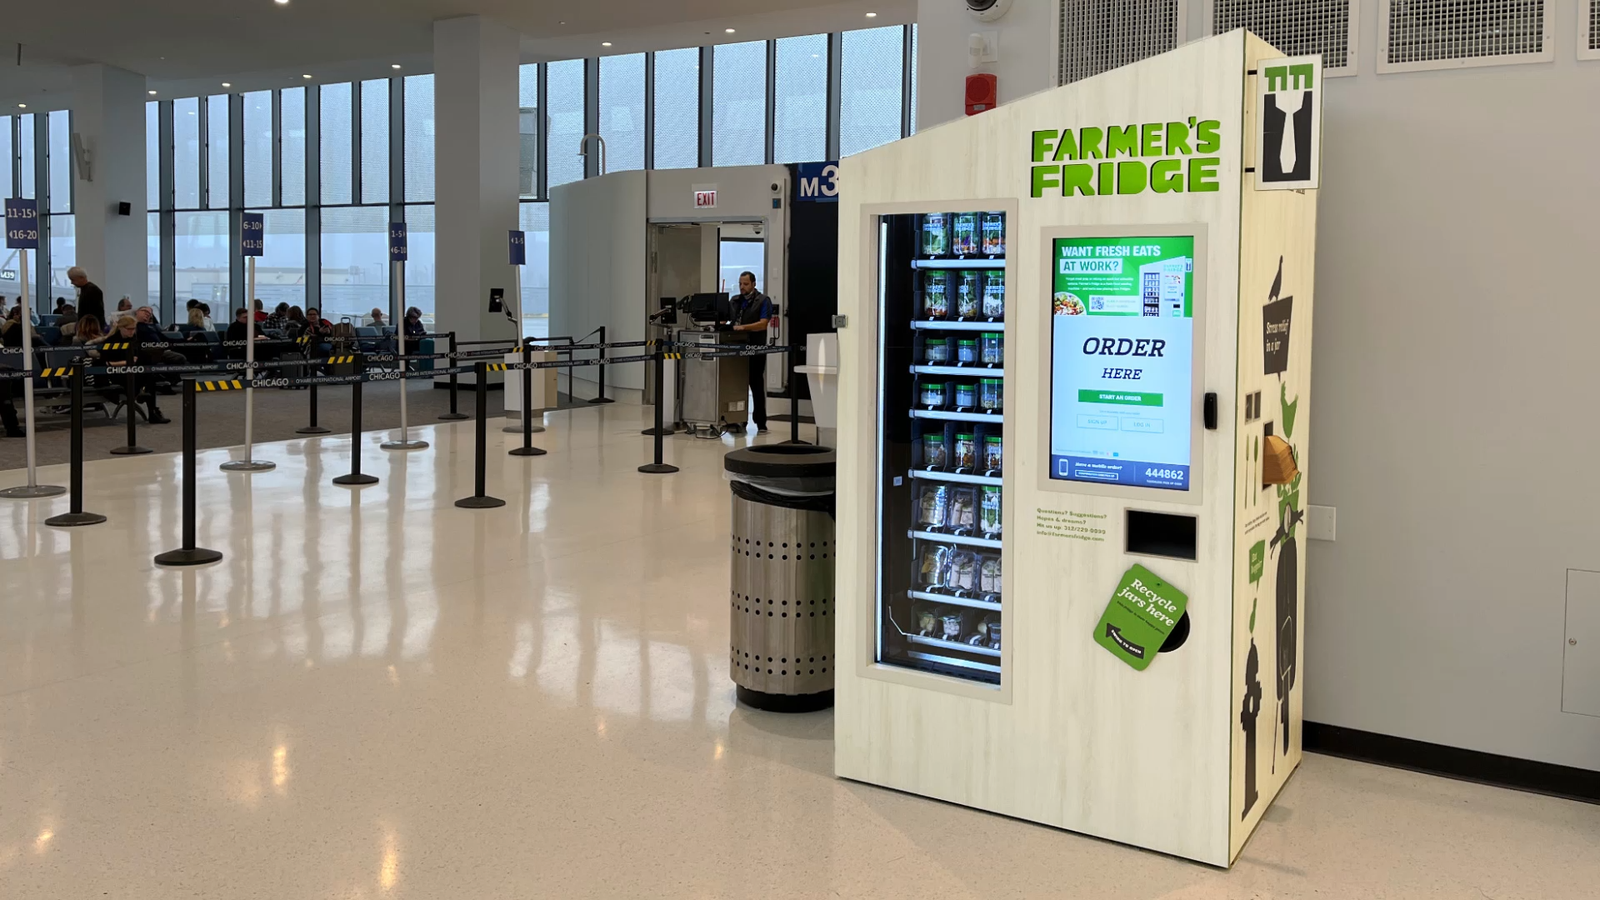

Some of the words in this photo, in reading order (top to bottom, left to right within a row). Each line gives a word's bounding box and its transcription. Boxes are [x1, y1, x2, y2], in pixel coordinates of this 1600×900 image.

[1031, 116, 1221, 162] FARMER'S
[1030, 157, 1220, 198] FRIDGE
[696, 192, 715, 206] EXIT
[7, 208, 32, 218] 11-15
[243, 221, 260, 230] 6-10
[13, 230, 37, 239] 16-20
[391, 230, 402, 238] 1-5
[246, 240, 263, 248] 11-15
[1061, 246, 1093, 257] WANT
[1095, 246, 1130, 257] FRESH
[1133, 245, 1161, 256] EATS
[1063, 261, 1076, 271] AT
[1079, 261, 1119, 271] WORK?
[2, 347, 34, 355] CHICAO
[1082, 337, 1166, 357] ORDER
[444, 351, 467, 359] CHICAGO
[106, 365, 145, 374] CHICAGO
[226, 361, 259, 370] CHICAGO
[251, 378, 289, 387] CHICAGO
[369, 372, 400, 381] CHICAGO
[1101, 367, 1143, 380] HERE
[1145, 467, 1184, 480] 444862
[1036, 507, 1068, 515] Questions?
[1069, 511, 1107, 519] Suggestions?
[1130, 578, 1177, 613] Recycle
[1117, 586, 1146, 608] jars
[1146, 603, 1174, 627] here
